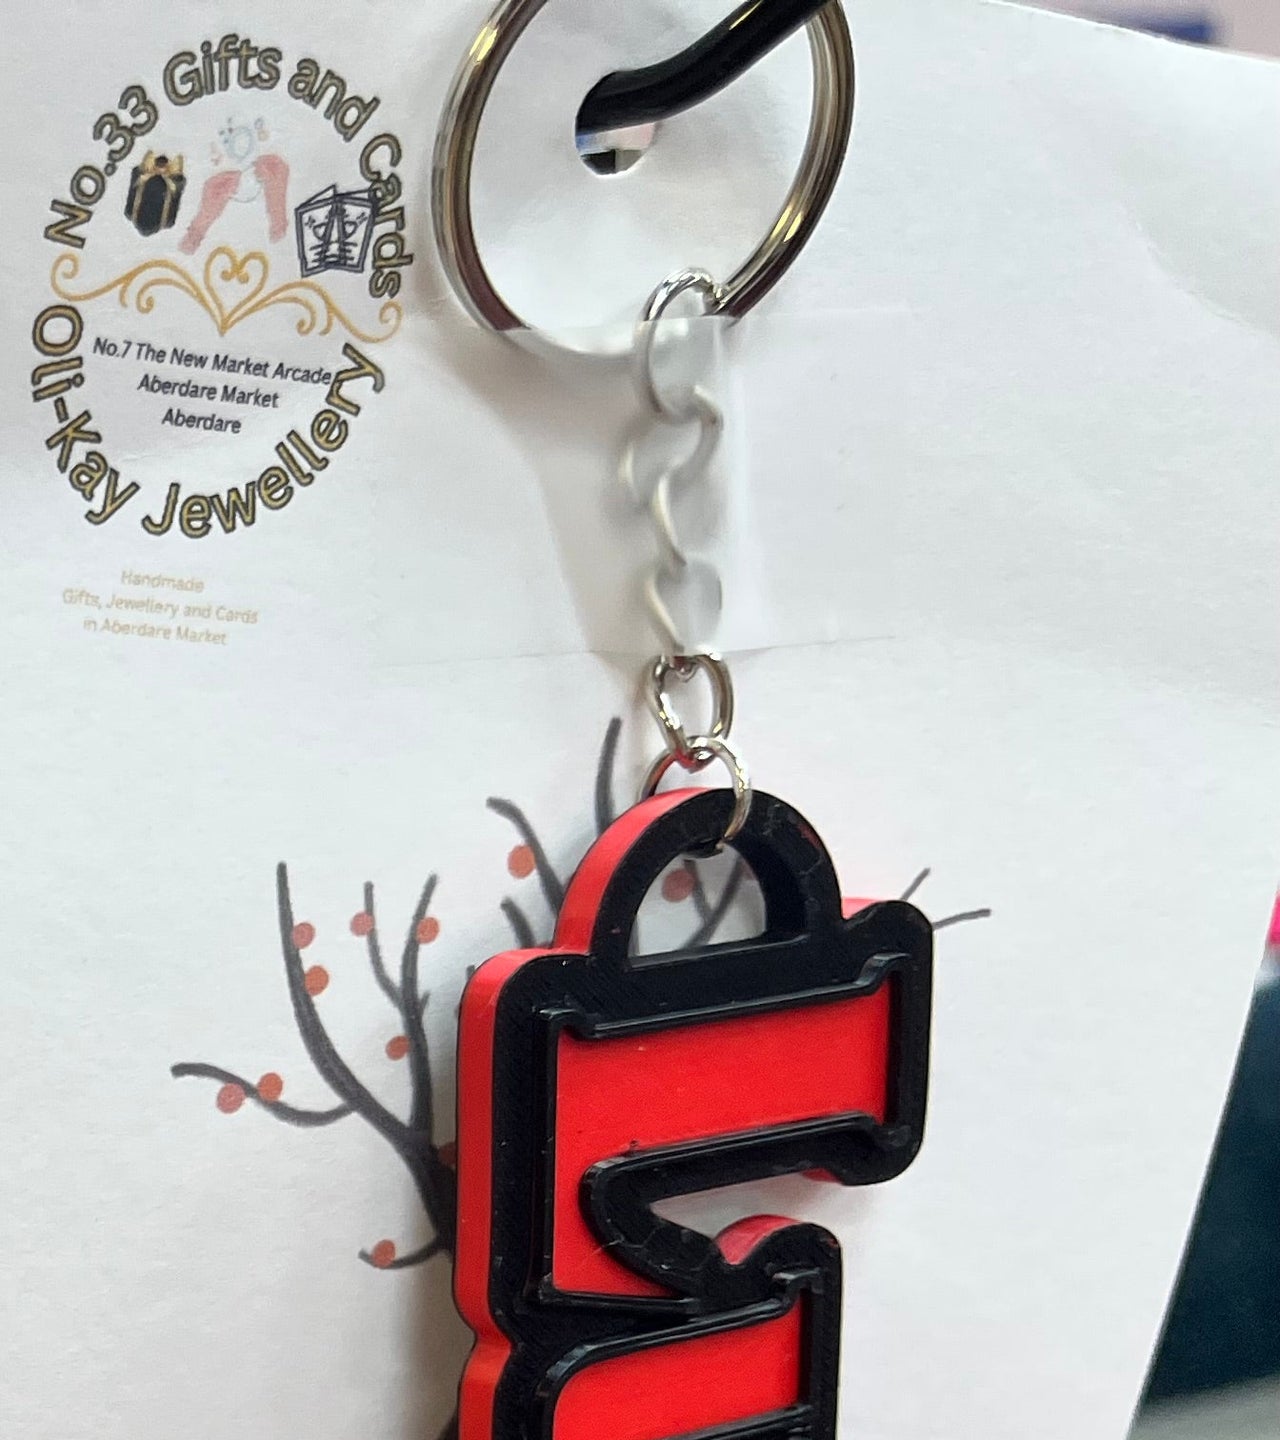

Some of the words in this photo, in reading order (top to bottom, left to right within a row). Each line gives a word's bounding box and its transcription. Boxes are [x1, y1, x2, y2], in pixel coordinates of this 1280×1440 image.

[43, 85, 159, 249] No.33
[163, 33, 282, 106] Gifts
[287, 58, 381, 142] and
[359, 133, 413, 299] Cards
[93, 337, 131, 358] No.7
[136, 343, 165, 363] The
[170, 348, 208, 369] New
[212, 354, 269, 378] Market
[272, 362, 332, 385] Arcade
[137, 374, 217, 401] Aberdare
[221, 385, 279, 408] Market
[31, 304, 140, 525] Oli-Kay
[141, 342, 385, 539] Jewellery
[161, 408, 241, 434] Aberdare
[183, 605, 212, 619] and
[100, 618, 171, 640] Aberdare
[176, 626, 227, 645] Market
